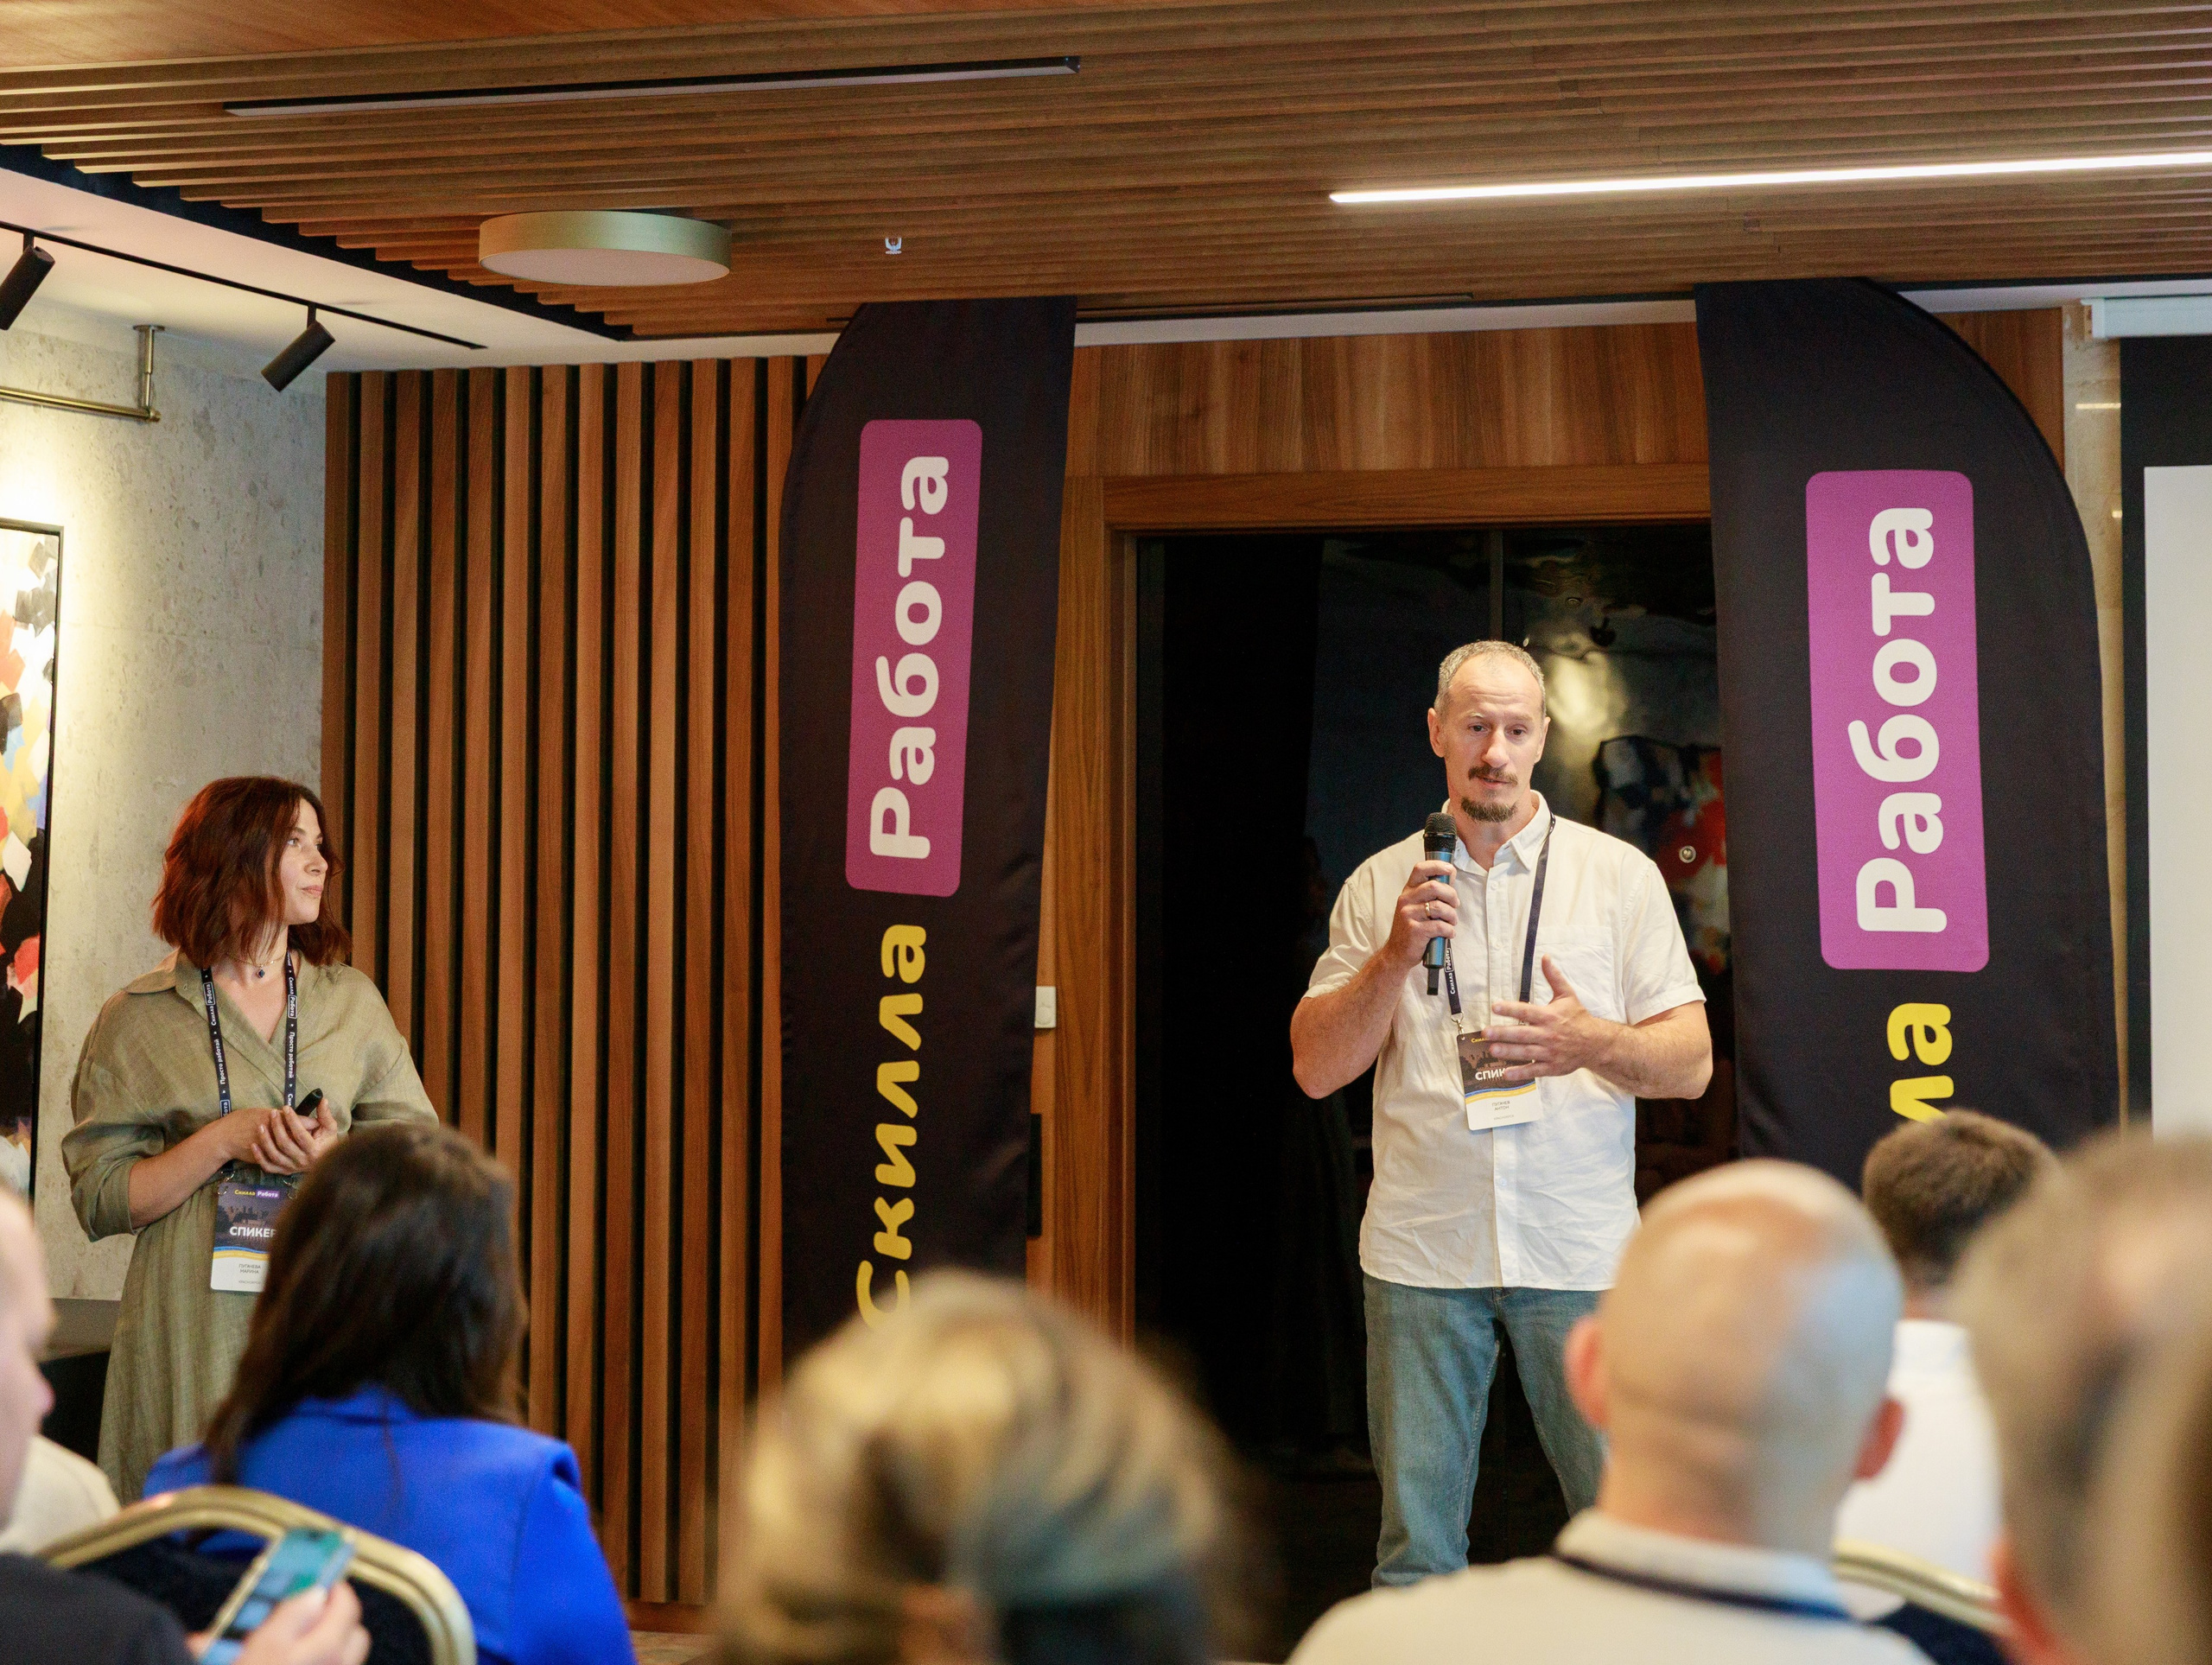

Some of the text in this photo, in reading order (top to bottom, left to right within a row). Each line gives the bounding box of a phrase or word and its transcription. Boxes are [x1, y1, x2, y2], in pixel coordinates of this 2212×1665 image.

[1847, 507, 1948, 934] Работа
[856, 455, 950, 1328] Скилла Работа
[213, 1039, 223, 1063] работай
[1474, 1067, 1505, 1081] СПИК
